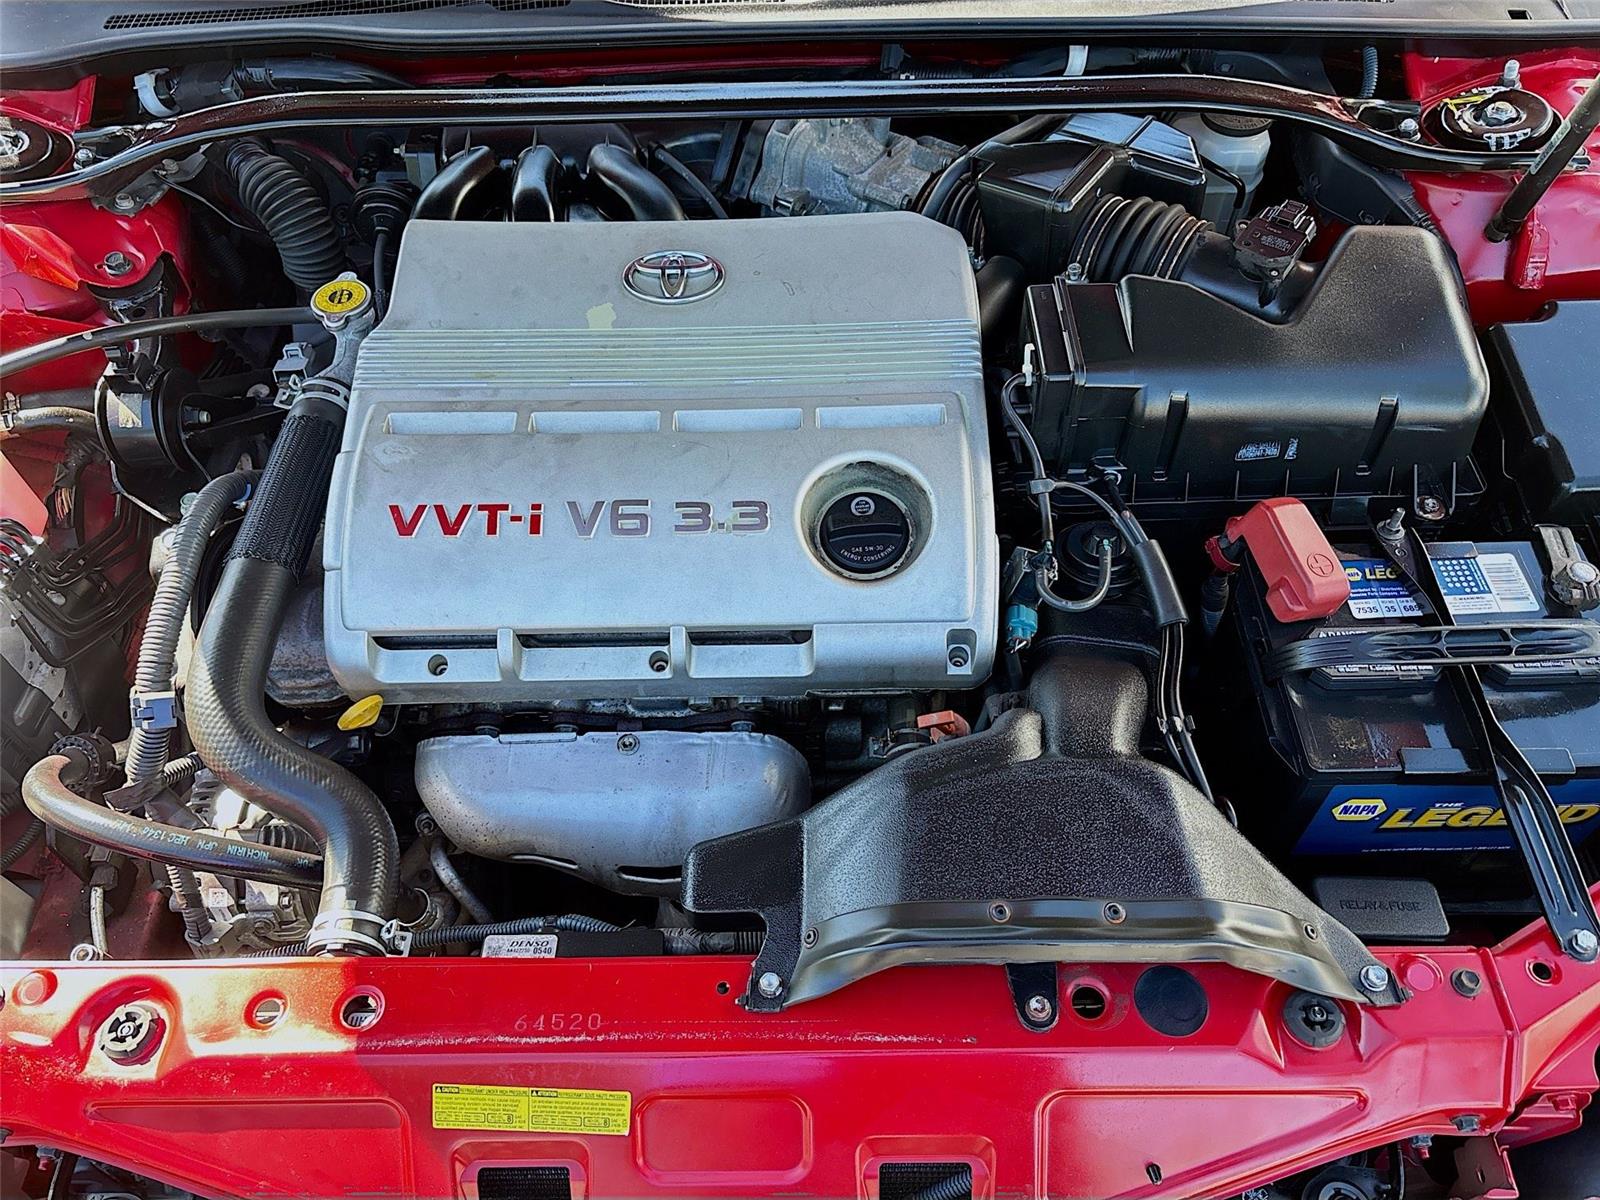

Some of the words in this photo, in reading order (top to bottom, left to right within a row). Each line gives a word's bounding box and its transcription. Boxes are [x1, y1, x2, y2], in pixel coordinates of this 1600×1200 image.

[388, 502, 544, 538] VVT-i
[565, 499, 651, 538] V6
[674, 500, 771, 535] 3.3
[840, 549, 861, 561] ENERGY
[862, 544, 896, 562] CONSERVING
[1339, 804, 1379, 816] NAPA
[1379, 803, 1600, 829] LEGED
[510, 940, 550, 948] DENSO
[533, 947, 553, 955] 0540
[514, 1012, 601, 1031] 64520
